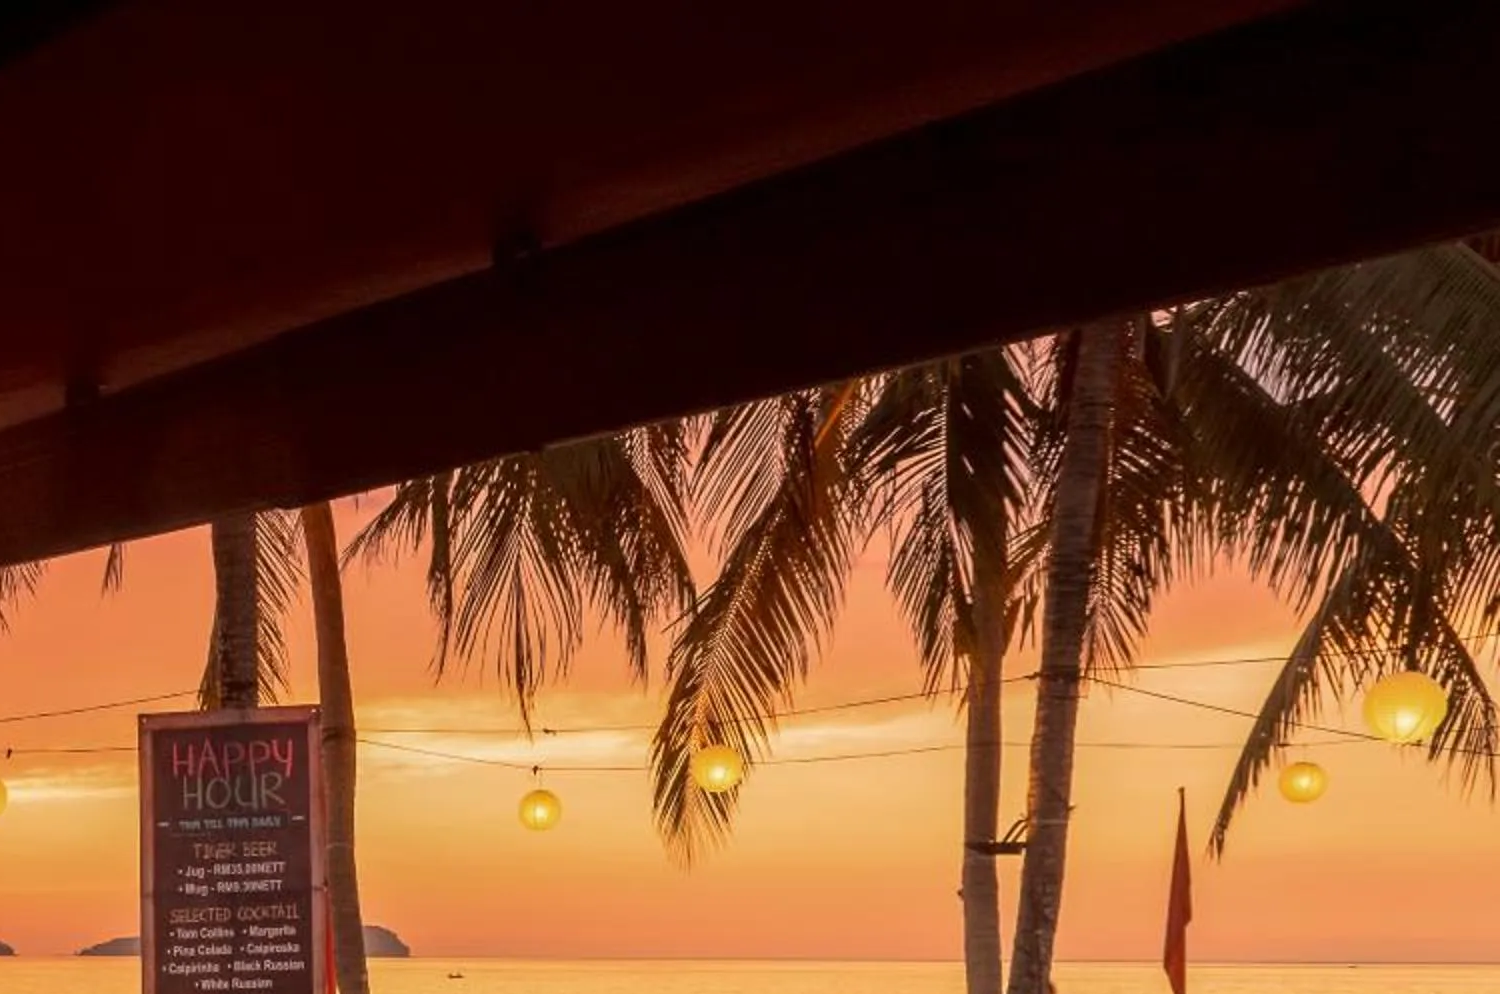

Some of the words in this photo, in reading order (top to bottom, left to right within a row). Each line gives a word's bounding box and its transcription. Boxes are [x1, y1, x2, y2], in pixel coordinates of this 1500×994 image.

[172, 737, 294, 780] HAPPY
[182, 772, 286, 810] HOUR
[193, 842, 237, 859] TIGER
[242, 840, 278, 857] BEER
[185, 865, 205, 879] Jug
[185, 883, 209, 897] Mug
[169, 906, 232, 924] SELECTED
[237, 902, 301, 921] COCKTAIL
[177, 928, 199, 939] Tom
[200, 926, 236, 939] Collins
[197, 944, 233, 956] Colada
[263, 959, 305, 971] Russian
[201, 978, 230, 990] White
[231, 977, 273, 990] Russian
